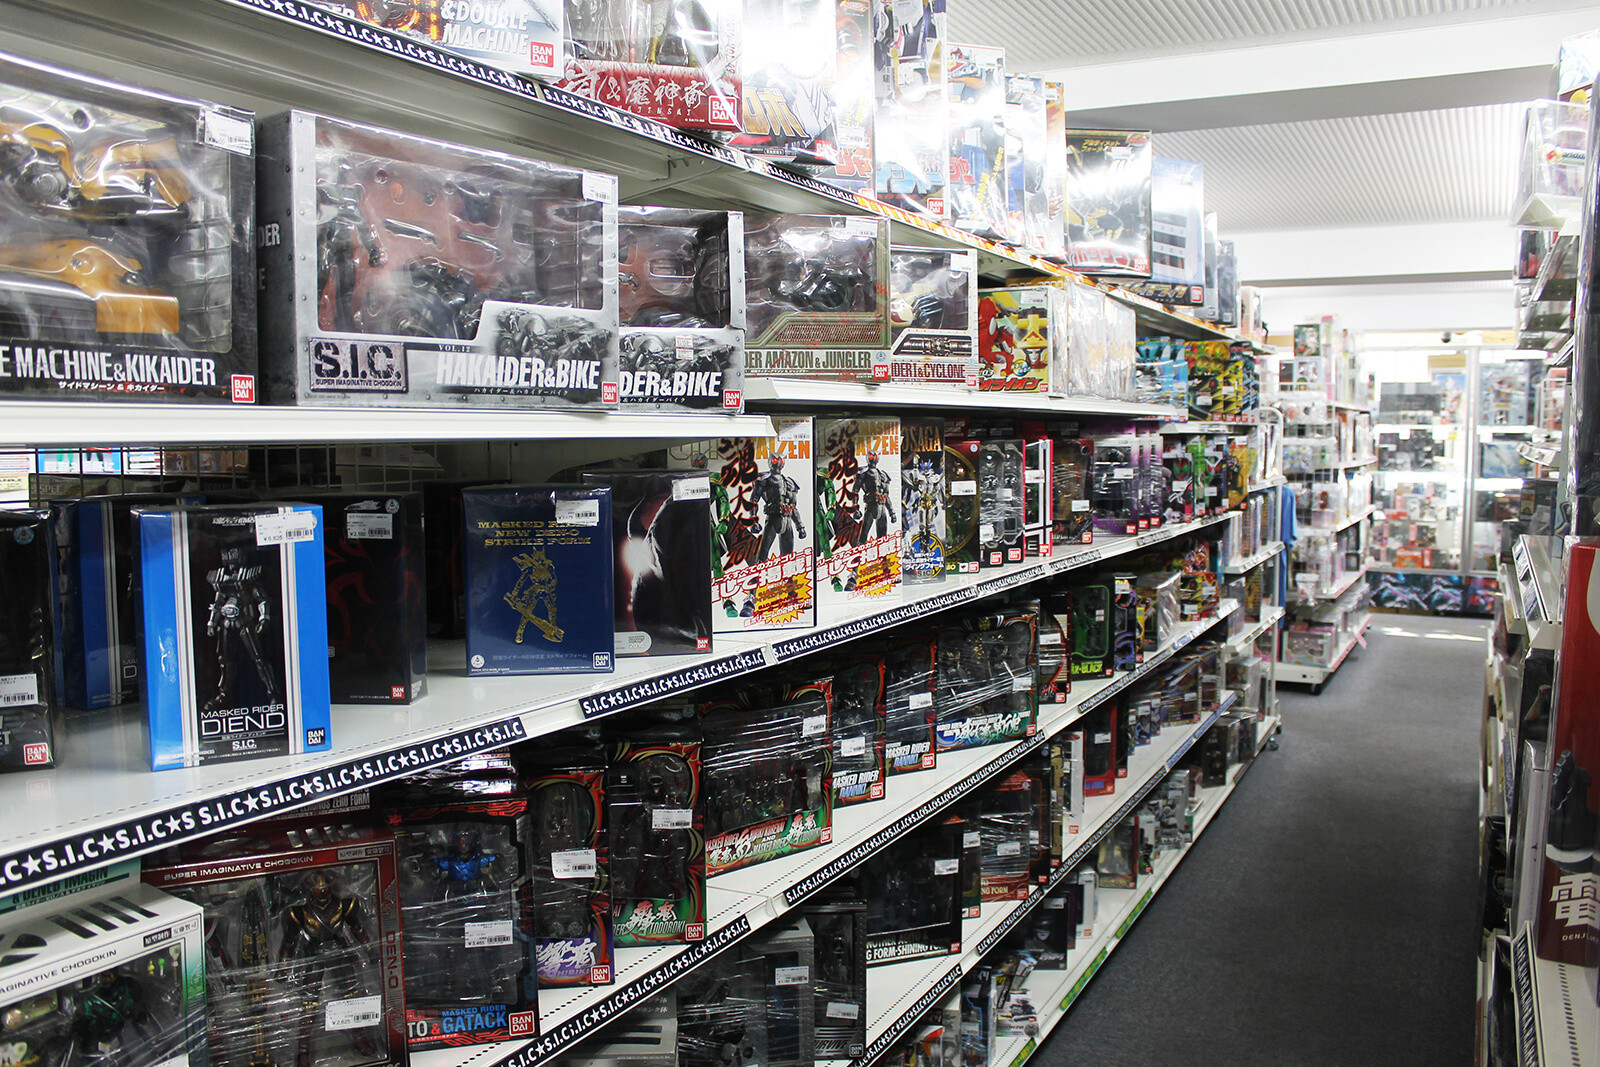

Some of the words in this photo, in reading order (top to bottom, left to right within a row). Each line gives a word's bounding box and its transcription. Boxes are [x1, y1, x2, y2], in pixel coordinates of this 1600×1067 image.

[442, 24, 529, 56] MACHINE
[315, 341, 402, 380] S.I.C.
[765, 351, 813, 369] AMAZON
[822, 351, 872, 370] JUNGLER
[235, 380, 253, 390] BAN
[235, 389, 249, 399] DAI
[603, 392, 617, 401] DAI
[725, 391, 740, 399] BAN
[725, 399, 738, 407] DAI
[477, 520, 544, 529] MASKED
[495, 529, 529, 537] NEW
[485, 538, 544, 547] STRIKE
[547, 537, 592, 546] FORM
[595, 654, 609, 662] BAN
[200, 706, 249, 719] MASKED
[252, 703, 284, 714] RIDER
[201, 711, 286, 735] DIEND
[307, 729, 324, 738] BAN
[307, 736, 321, 745] DAI
[26, 744, 46, 755] BAN
[859, 769, 880, 785] RIDER
[164, 870, 197, 881] SUPER
[200, 862, 262, 877] IMAGINATIVE
[61, 949, 117, 974] CHOGOKIN
[442, 1007, 478, 1018] MASKED
[480, 1003, 507, 1013] RIDER
[442, 1011, 507, 1034] GATACK
[512, 1015, 532, 1024] BAN
[512, 1023, 528, 1032] DAI
